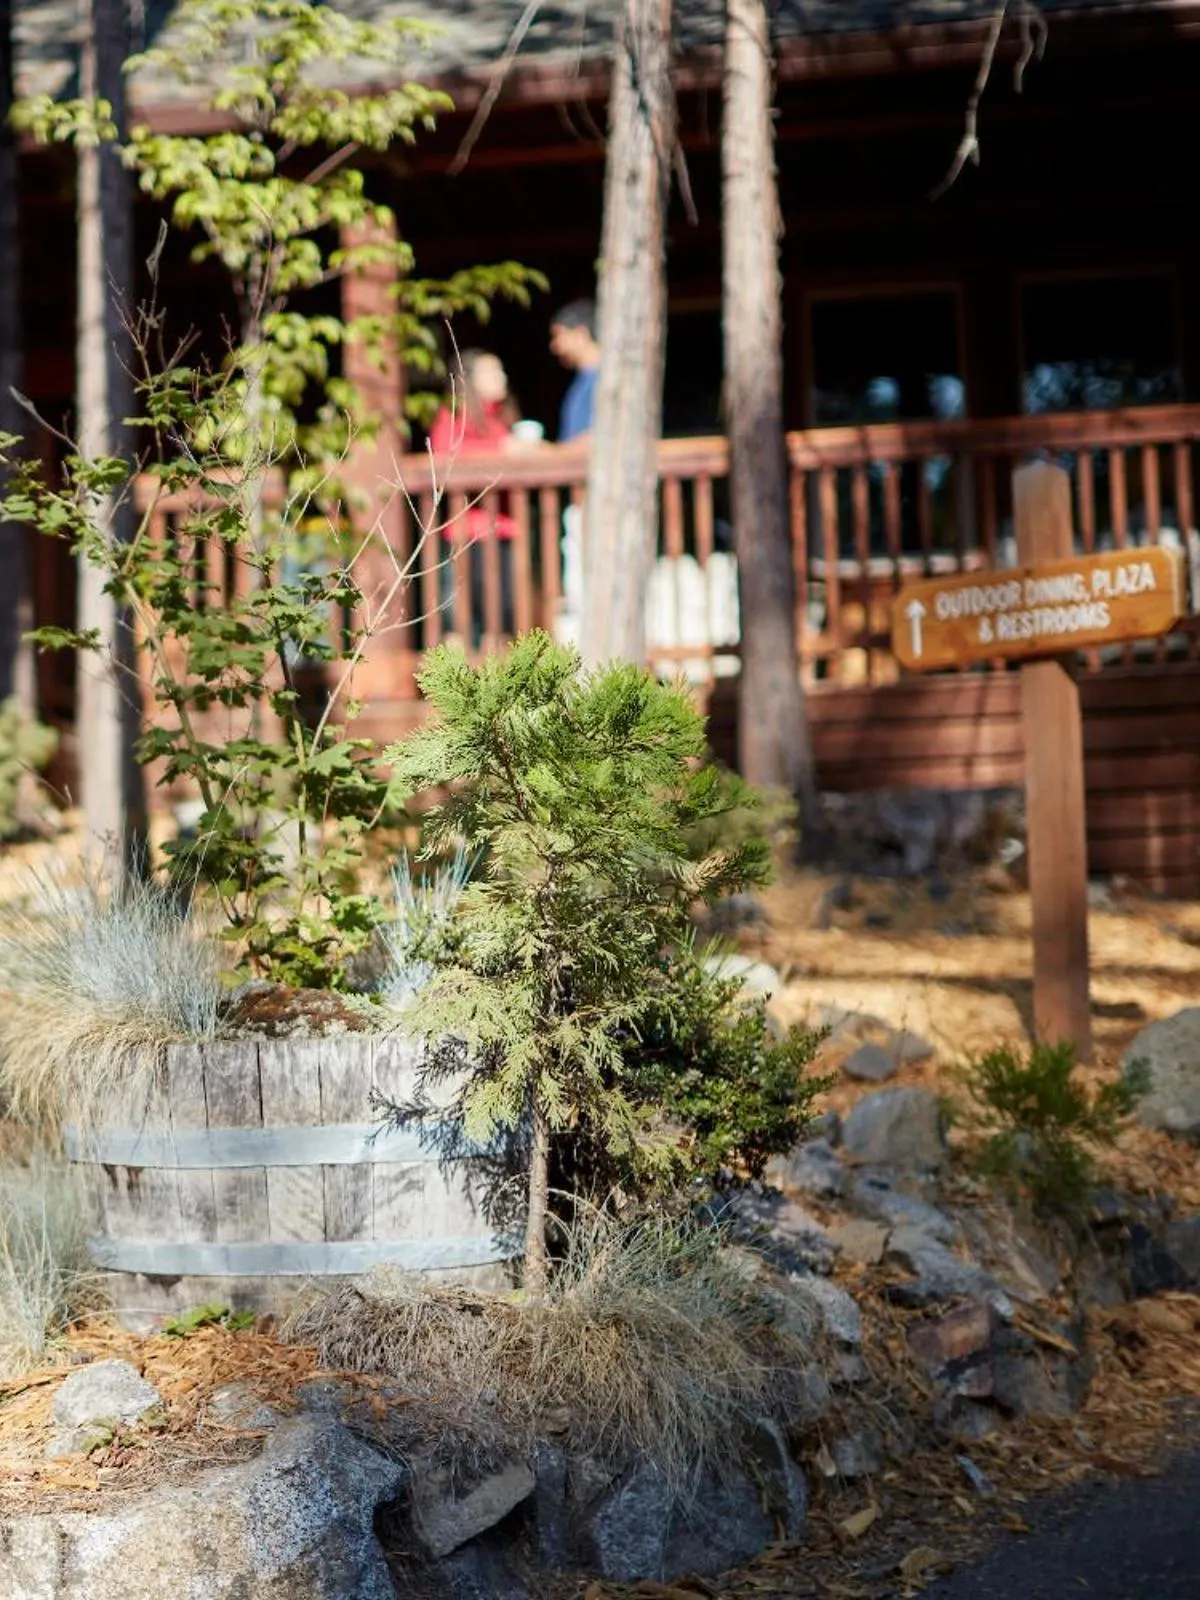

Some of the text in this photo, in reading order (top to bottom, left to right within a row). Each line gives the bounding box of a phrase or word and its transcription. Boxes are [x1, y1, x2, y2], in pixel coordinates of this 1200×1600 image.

[936, 580, 1022, 620] OUTDOOR
[1091, 562, 1157, 597] PLAZA
[996, 602, 1112, 640] RESTROOMS
